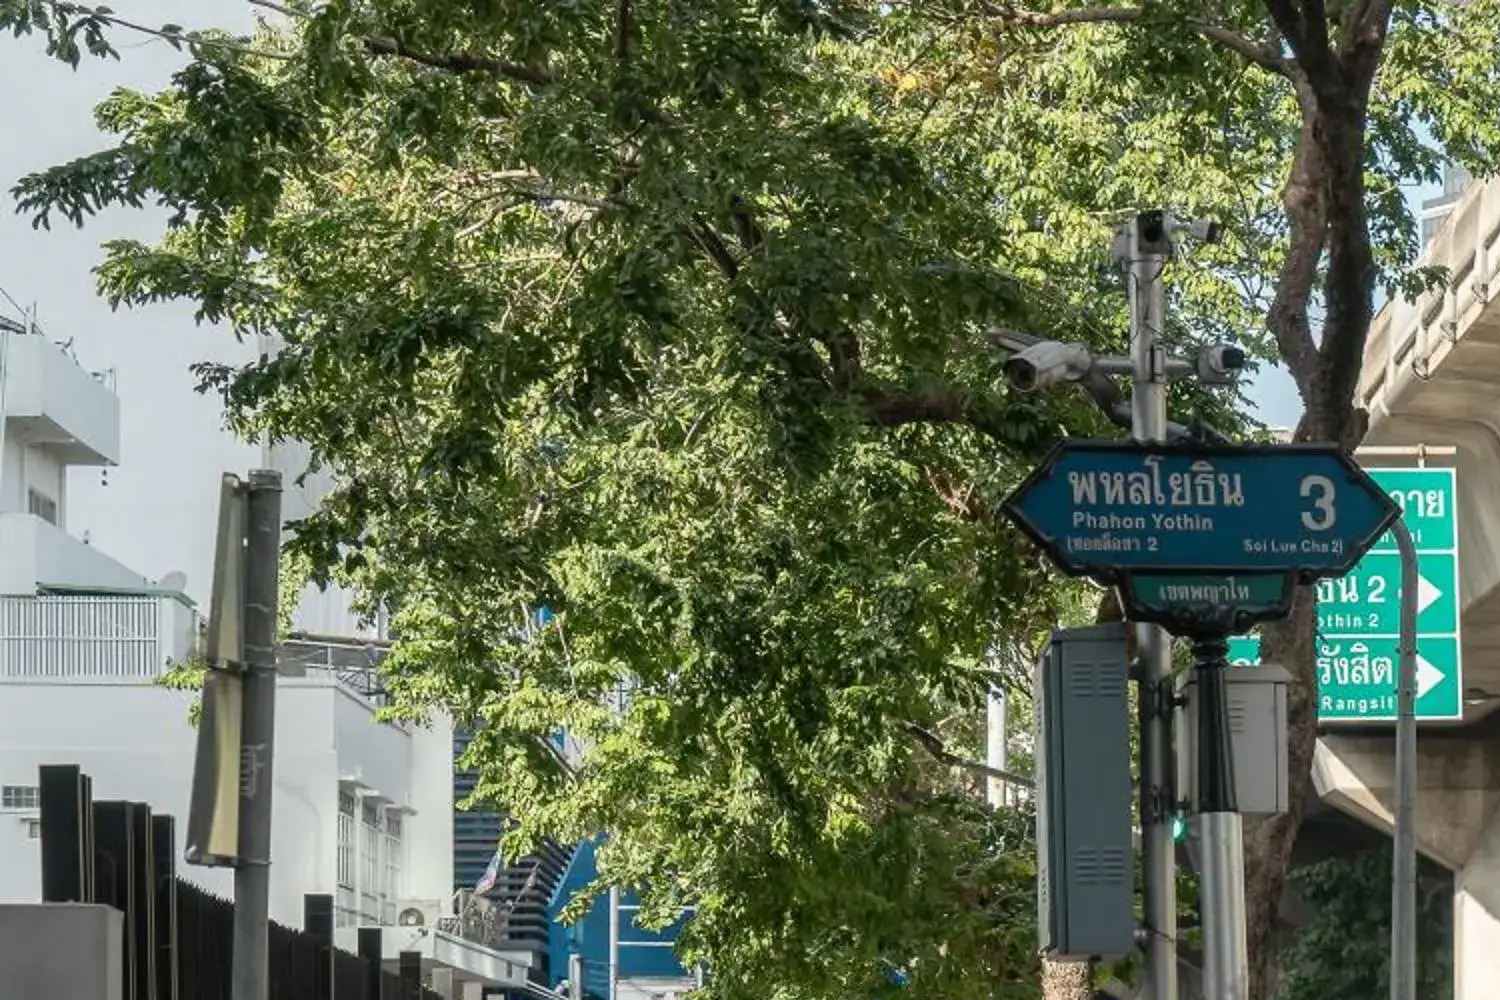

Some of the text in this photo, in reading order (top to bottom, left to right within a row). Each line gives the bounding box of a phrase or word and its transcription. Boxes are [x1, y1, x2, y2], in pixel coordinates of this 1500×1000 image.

[1068, 455, 1336, 531] พหลโยธิน 3
[1073, 511, 1214, 531] Phahon Yothin
[1147, 536, 1160, 551] 2
[1243, 538, 1267, 554] Soi
[1301, 539, 1329, 553] Cha
[1367, 575, 1387, 604] 2
[1368, 613, 1380, 628] 2
[1317, 642, 1393, 685] รังสิต
[1321, 696, 1394, 713] Rangsit
